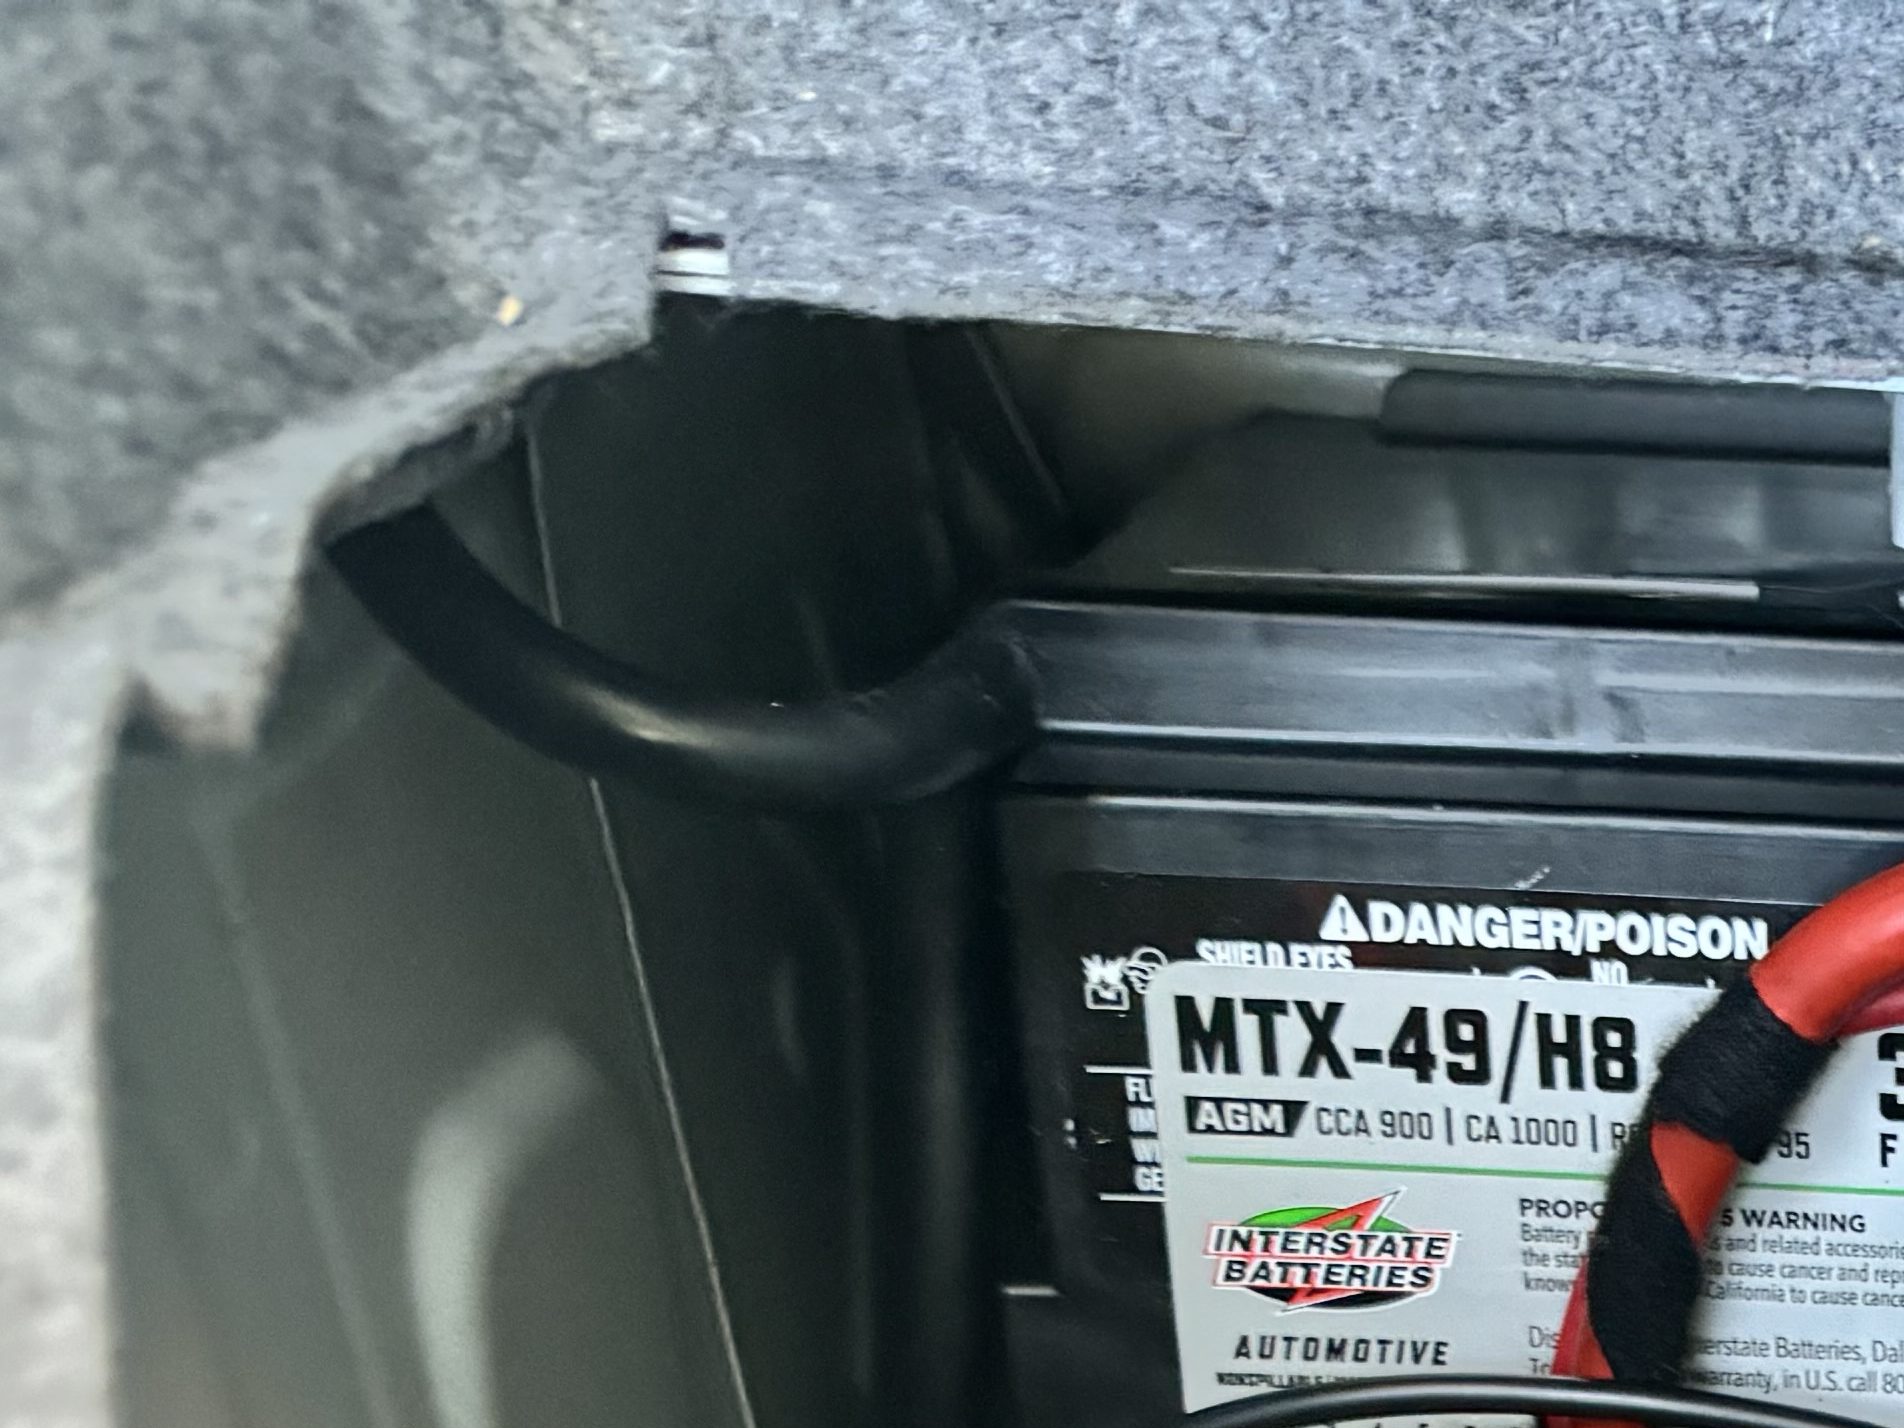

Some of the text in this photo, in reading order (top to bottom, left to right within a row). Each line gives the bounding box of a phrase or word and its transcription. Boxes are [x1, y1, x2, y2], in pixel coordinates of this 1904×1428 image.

[1369, 900, 1769, 960] DANGER/POISON
[1174, 994, 1639, 1104] MTX-49/H8
[1195, 1100, 1287, 1134] AGM
[1315, 1106, 1373, 1138] CCA
[1380, 1110, 1434, 1140] 900
[1466, 1113, 1502, 1143] CA
[1511, 1116, 1578, 1147] 1000
[1740, 1208, 1866, 1233] WARNING
[1214, 1227, 1450, 1260] INTERSTATE
[1520, 1223, 1581, 1249] Battery
[1725, 1233, 1757, 1252] and
[1762, 1234, 1821, 1256] related
[1223, 1259, 1434, 1289] BATTERIES
[1522, 1249, 1549, 1267] the
[1728, 1261, 1775, 1278] cause
[1780, 1263, 1834, 1281] cancer
[1836, 1262, 1869, 1282] and
[1790, 1286, 1807, 1304] to
[1811, 1290, 1858, 1306] cause
[1233, 1334, 1449, 1366] AUTOMOTIVE
[1775, 1336, 1867, 1365] Batteries,
[1783, 1368, 1801, 1389] in
[1805, 1370, 1844, 1392] U.S.
[1847, 1370, 1878, 1392] call
